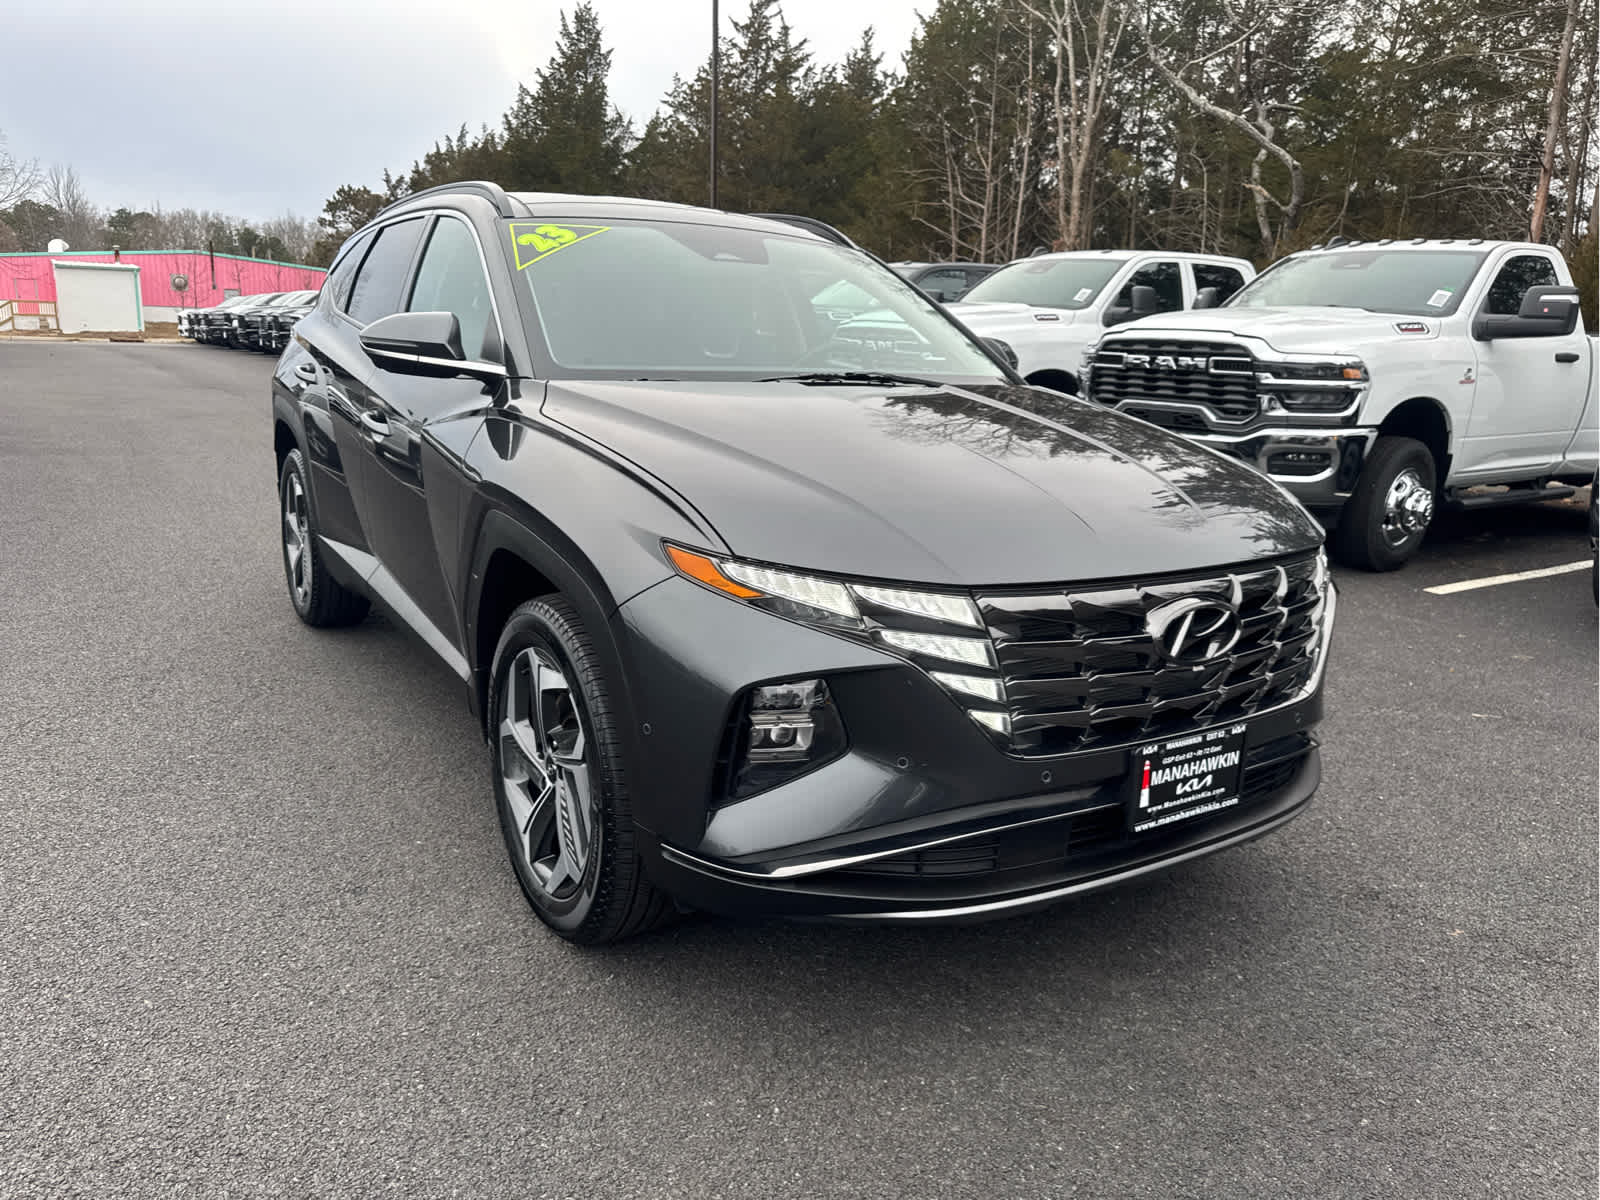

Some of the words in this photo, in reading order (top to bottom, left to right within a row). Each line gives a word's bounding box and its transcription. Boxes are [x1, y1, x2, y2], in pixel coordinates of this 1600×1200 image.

[517, 224, 577, 252] 23
[1127, 354, 1206, 370] RAM
[1150, 750, 1240, 787] MANAHAWKIN
[1134, 798, 1239, 832] www.manahawkinkia.com
